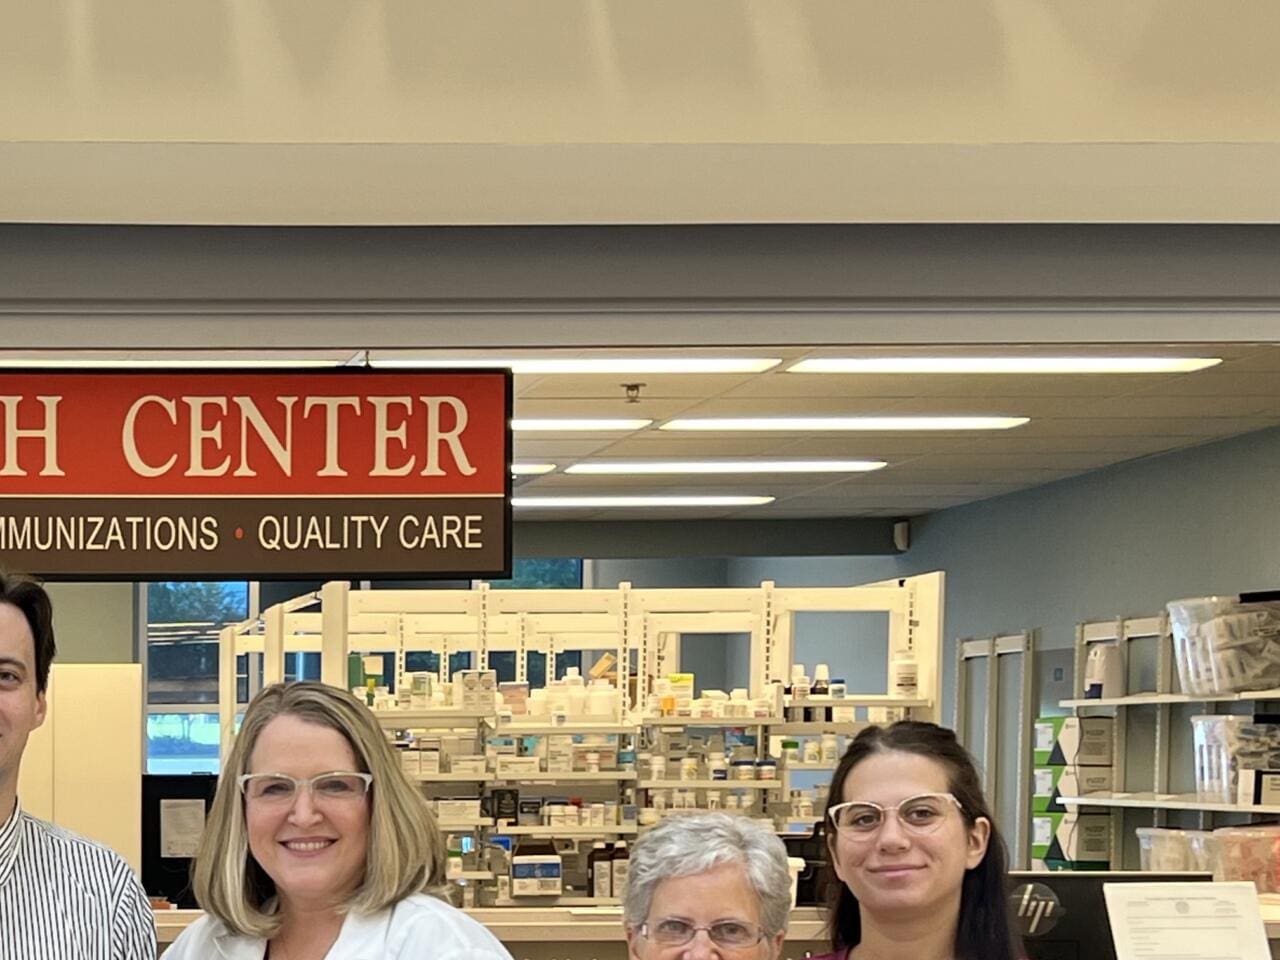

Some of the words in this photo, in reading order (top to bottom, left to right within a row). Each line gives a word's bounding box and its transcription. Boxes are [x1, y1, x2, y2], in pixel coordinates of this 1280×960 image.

[122, 394, 478, 478] CENTER
[258, 515, 389, 551] QUALITY
[399, 515, 483, 549] CARE
